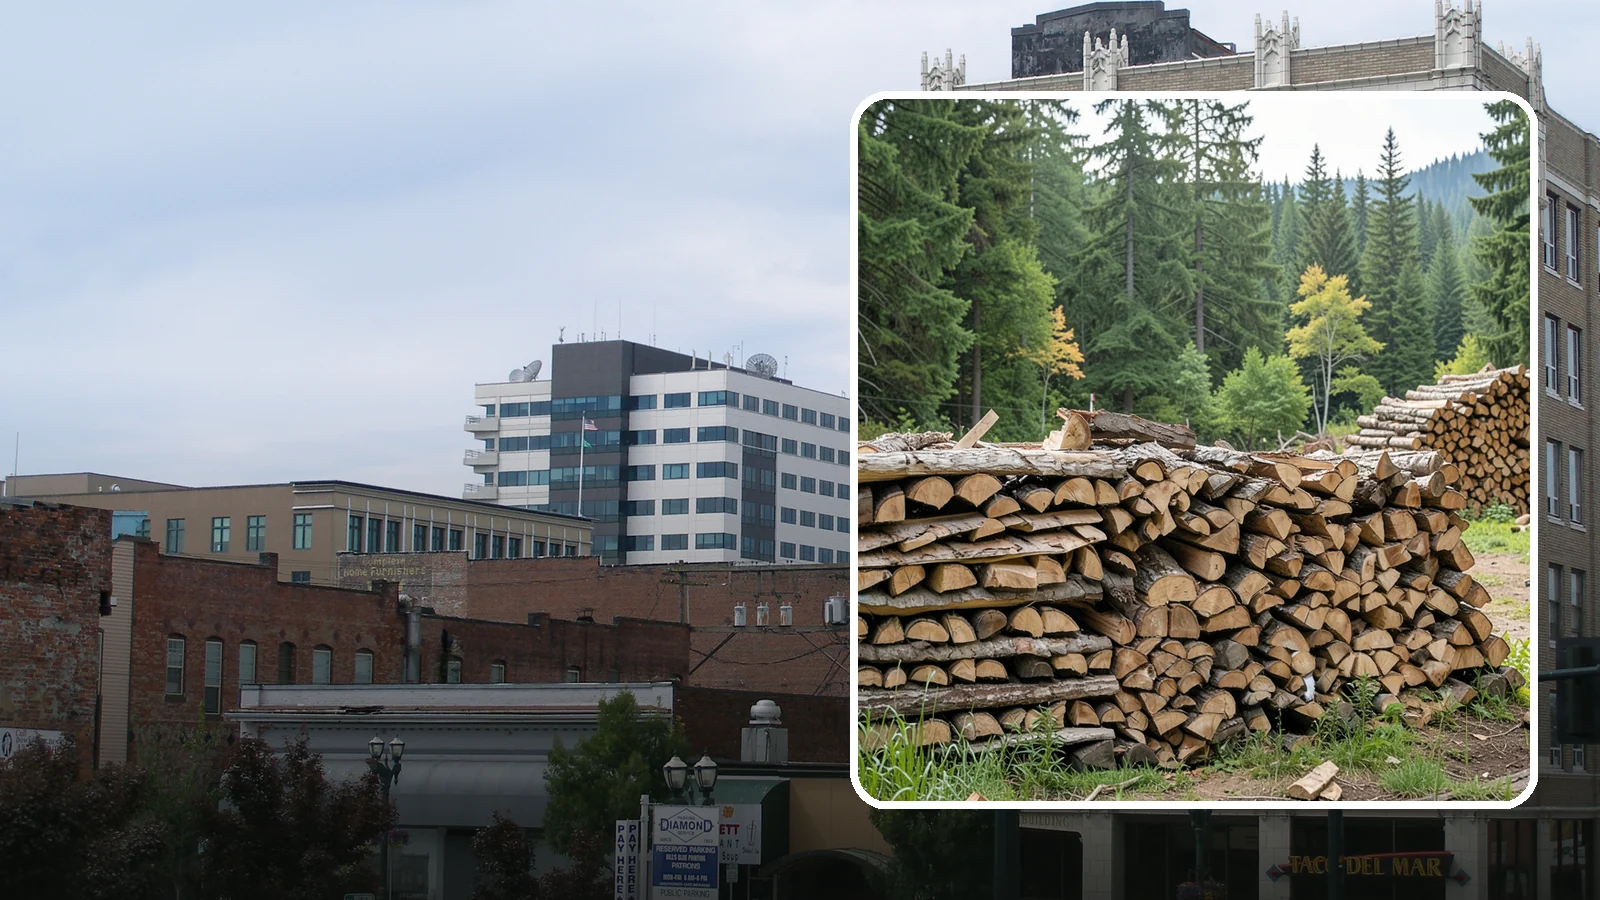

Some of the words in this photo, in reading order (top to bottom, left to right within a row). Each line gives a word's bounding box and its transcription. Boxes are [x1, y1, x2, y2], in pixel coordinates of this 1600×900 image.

[370, 566, 426, 576] Furnishers
[660, 818, 713, 832] DIAMOND
[1022, 815, 1069, 827] BUILDING
[617, 825, 625, 852] PAY
[628, 824, 637, 852] PAY
[689, 846, 716, 854] PARKING
[721, 851, 739, 862] Soup
[671, 862, 701, 870] PATRONS
[1345, 856, 1385, 875] DEL
[1392, 857, 1443, 877] MAR
[616, 856, 625, 893] HERE
[627, 856, 637, 893] HERE
[660, 888, 682, 897] PUBLIC
[683, 889, 710, 898] PARKING
